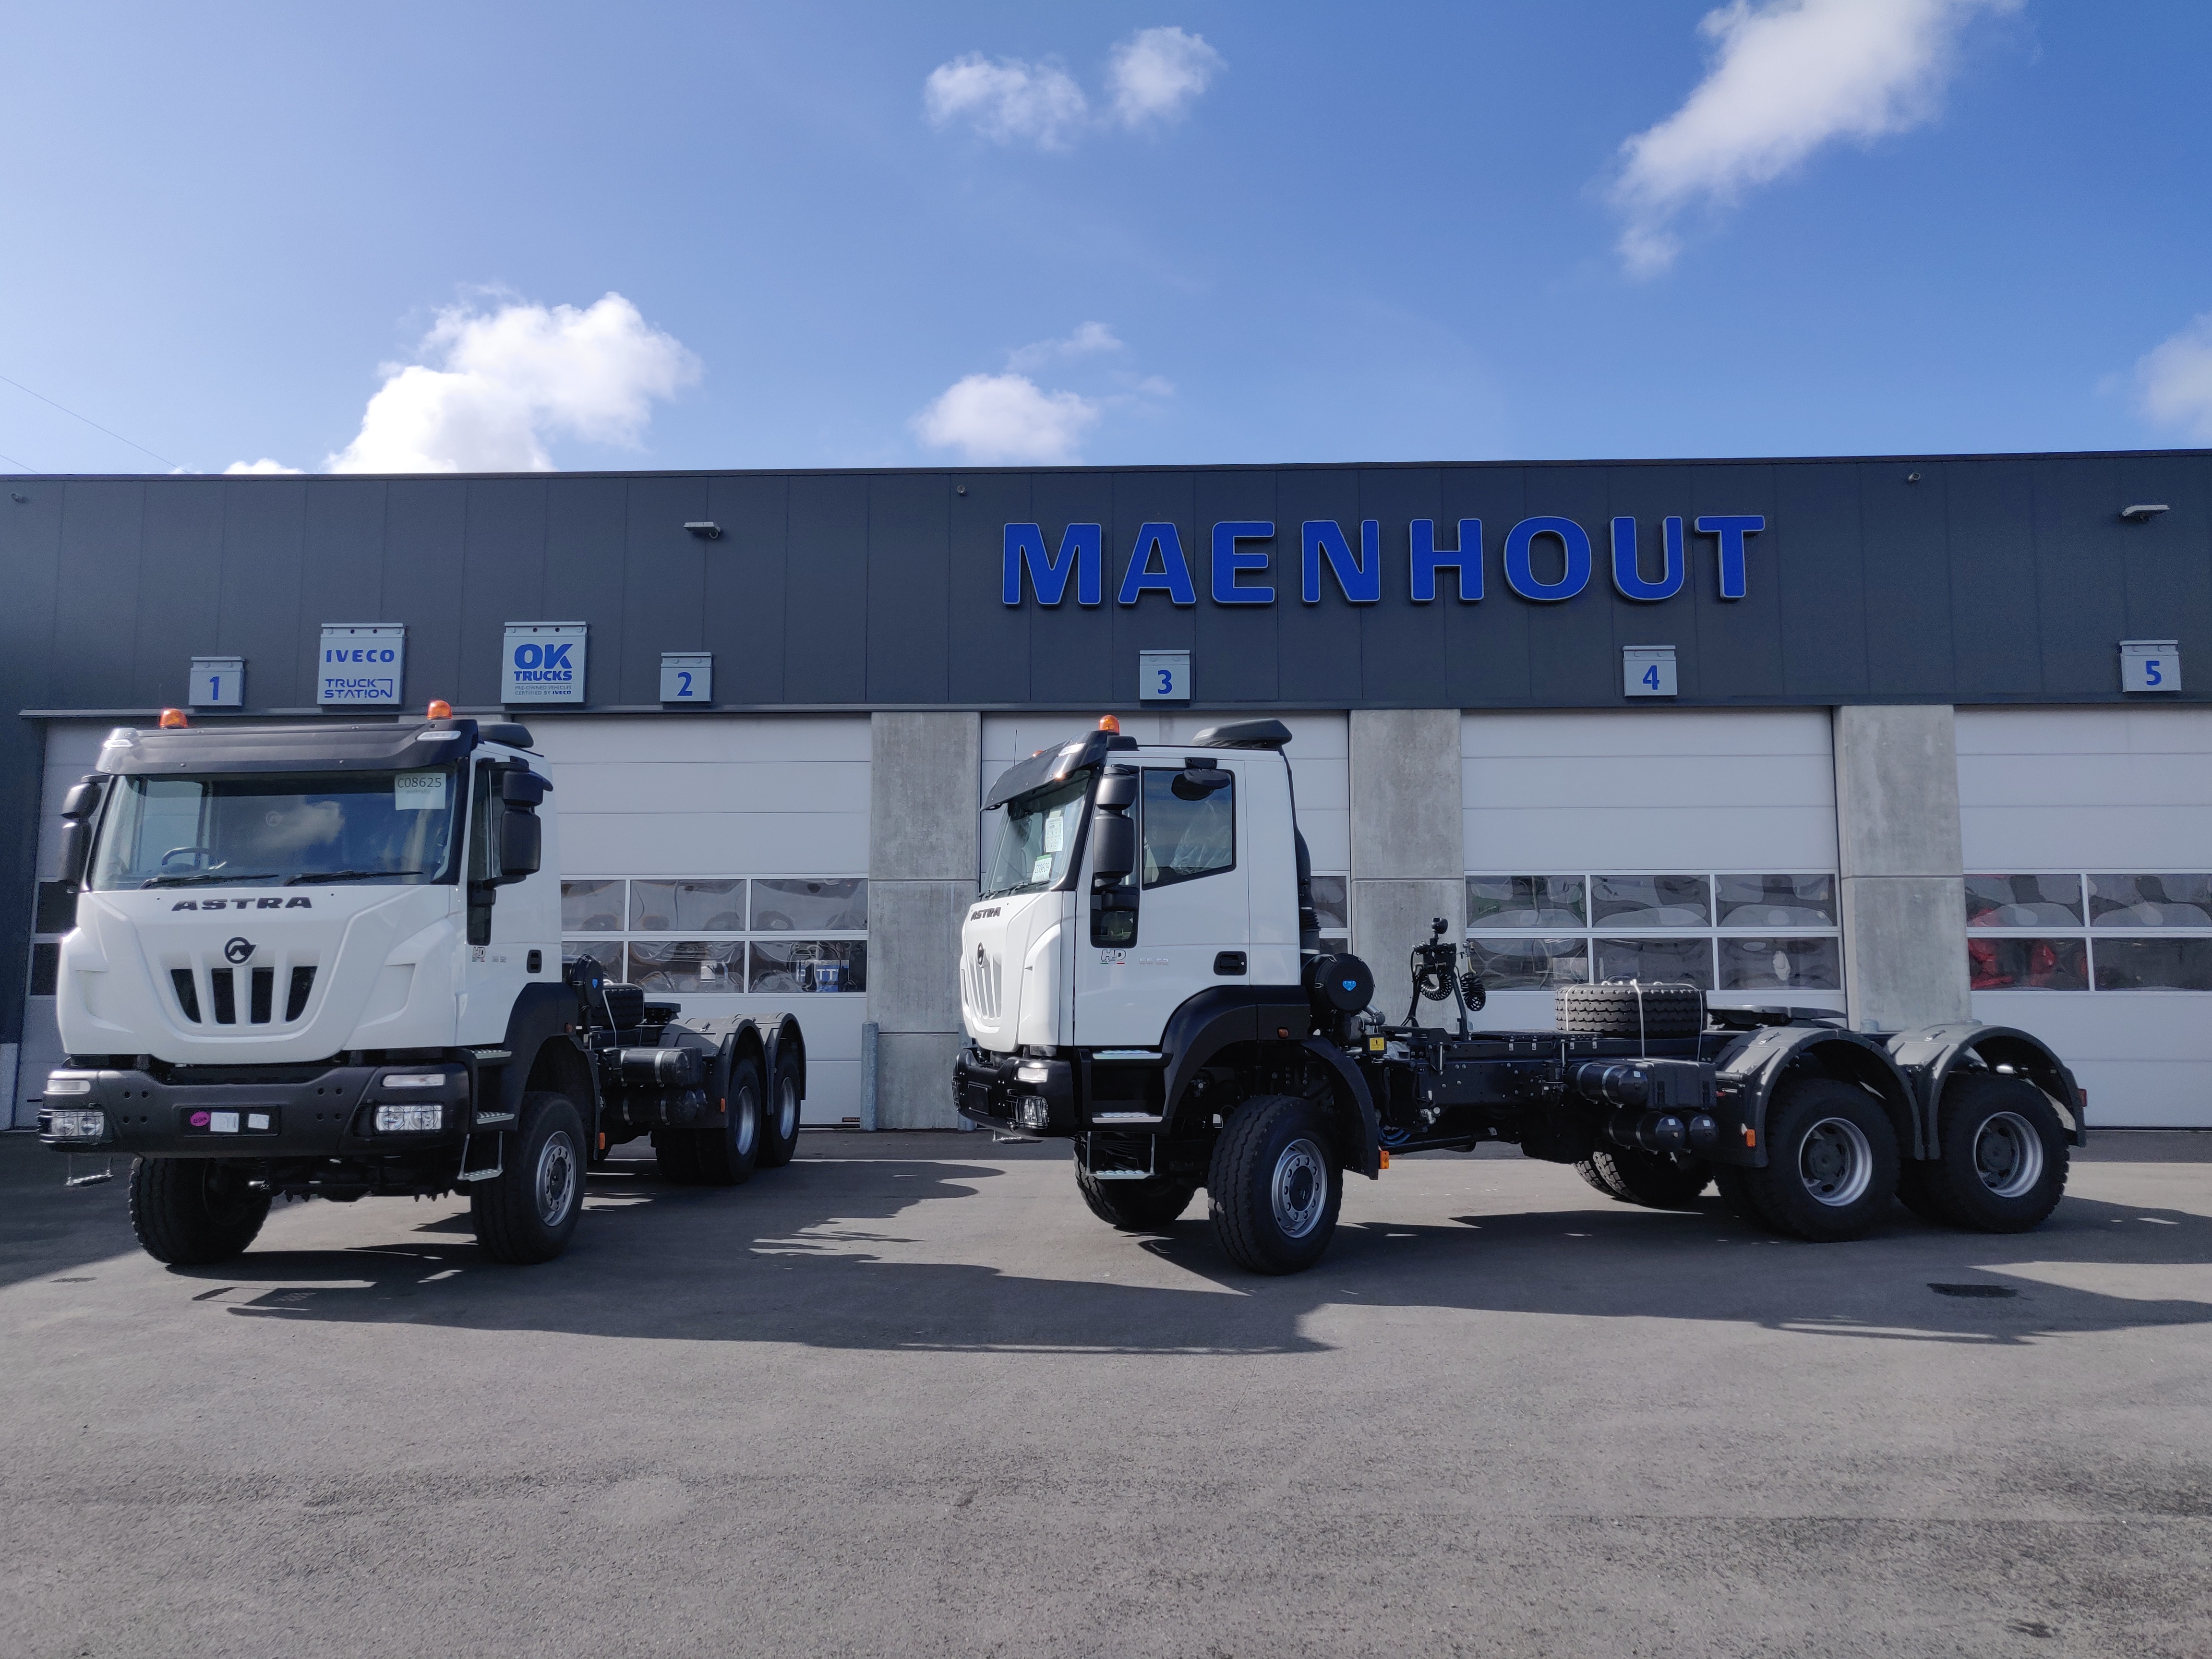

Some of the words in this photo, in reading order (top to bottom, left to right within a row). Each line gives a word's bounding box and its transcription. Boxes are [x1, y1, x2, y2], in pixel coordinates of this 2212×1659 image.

[1002, 514, 1766, 606] MAENHOUT
[326, 649, 395, 662] IVECO
[514, 644, 573, 670] OK
[514, 671, 572, 681] TRUCKS
[1642, 666, 1659, 690] 4
[2146, 661, 2162, 685] 5
[209, 676, 220, 700] 1
[325, 679, 377, 688] TRUCK
[677, 672, 693, 696] 2
[1157, 670, 1172, 695] 3
[324, 689, 393, 698] STATION
[397, 778, 442, 788] C08625
[171, 897, 313, 911] ASTRA
[970, 907, 1001, 921] ASTRA
[1101, 949, 1127, 961] HD
